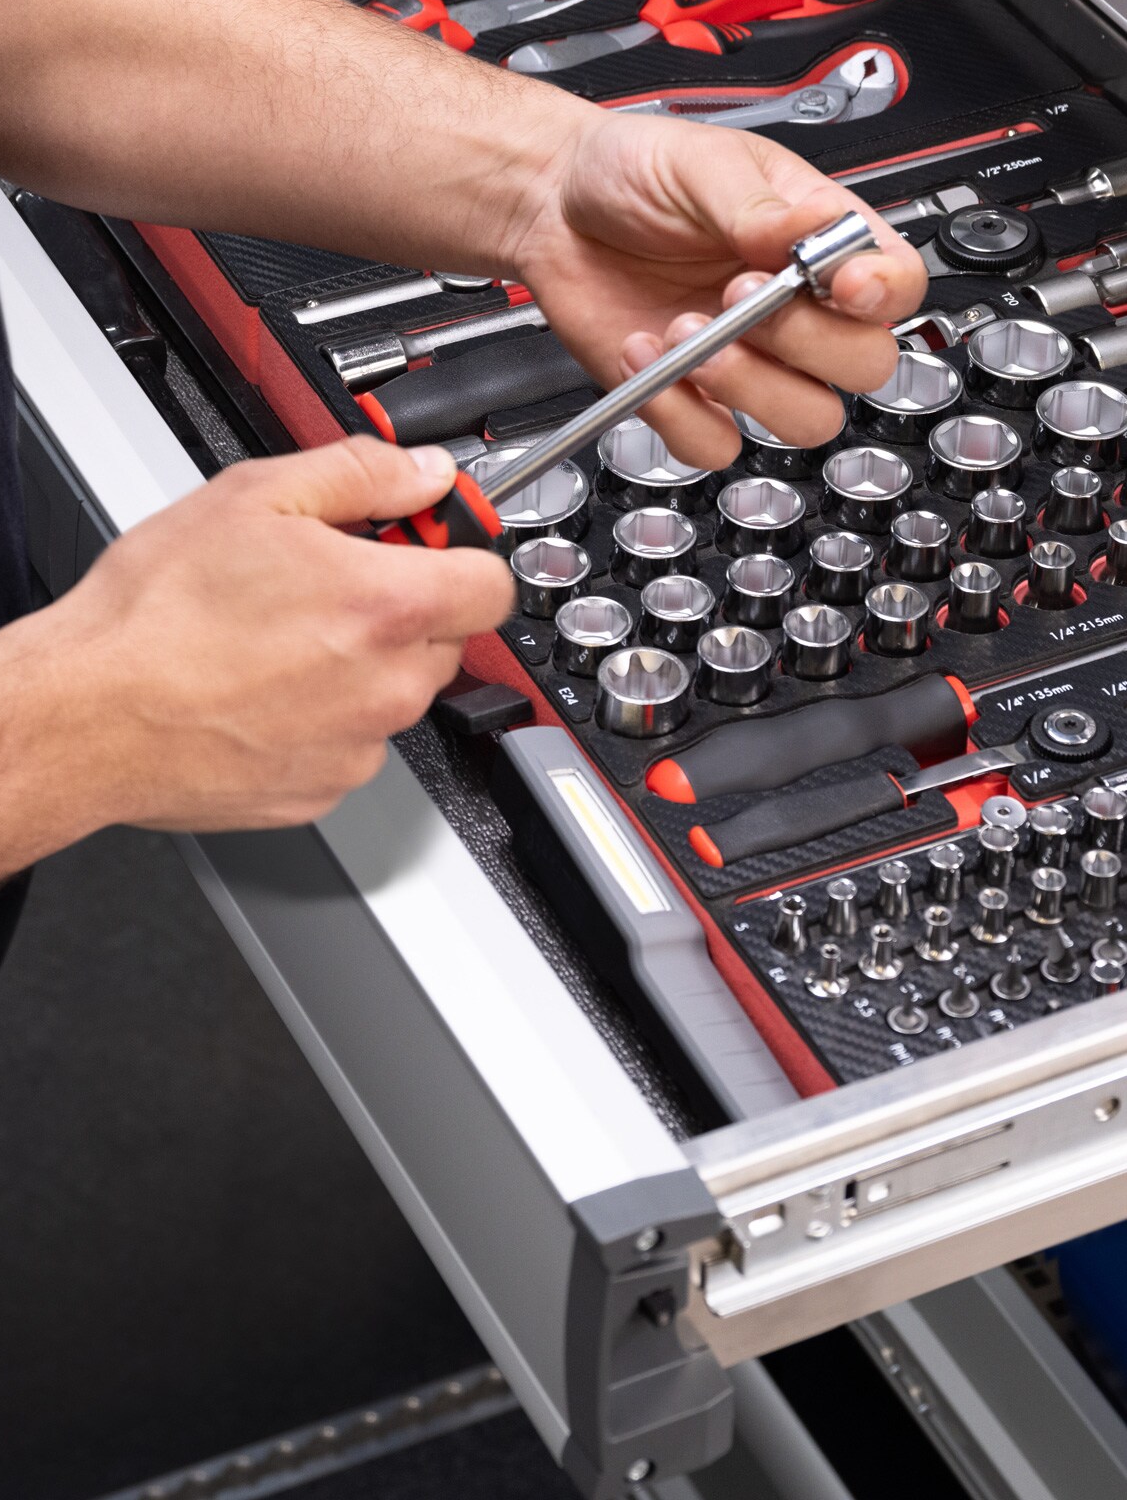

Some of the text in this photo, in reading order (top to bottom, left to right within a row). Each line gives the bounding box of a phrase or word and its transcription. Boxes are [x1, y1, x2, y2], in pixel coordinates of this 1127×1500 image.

[1046, 104, 1070, 116] 1/2"
[978, 156, 1042, 179] 1/2" 250mm
[1001, 291, 1020, 307] T20
[1049, 612, 1124, 641] 1/4" 215mm
[519, 634, 536, 647] 17
[558, 686, 579, 706] E24
[997, 682, 1074, 712] 1/4" 135mm
[1022, 767, 1051, 785] 1/4"
